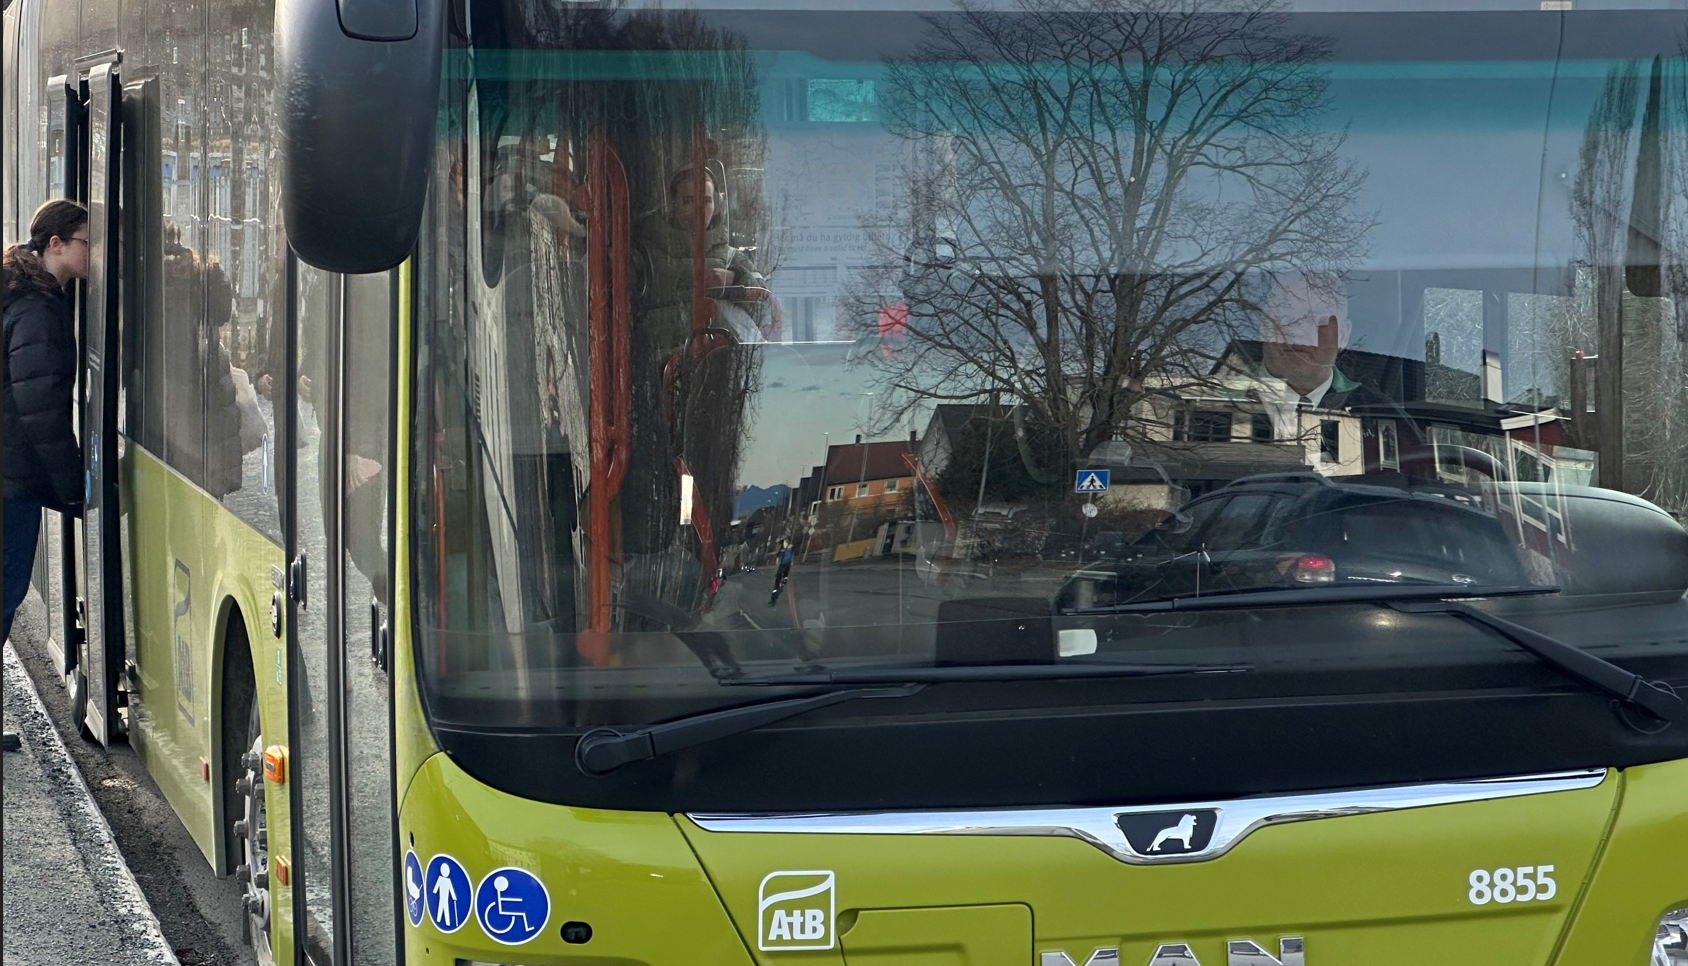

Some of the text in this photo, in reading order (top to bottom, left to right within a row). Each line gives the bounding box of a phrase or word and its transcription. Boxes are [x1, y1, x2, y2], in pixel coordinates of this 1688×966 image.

[806, 232, 818, 242] du
[820, 232, 831, 242] ha
[833, 232, 860, 243] gyldig
[1468, 864, 1557, 905] 8855
[767, 909, 825, 940] AtB
